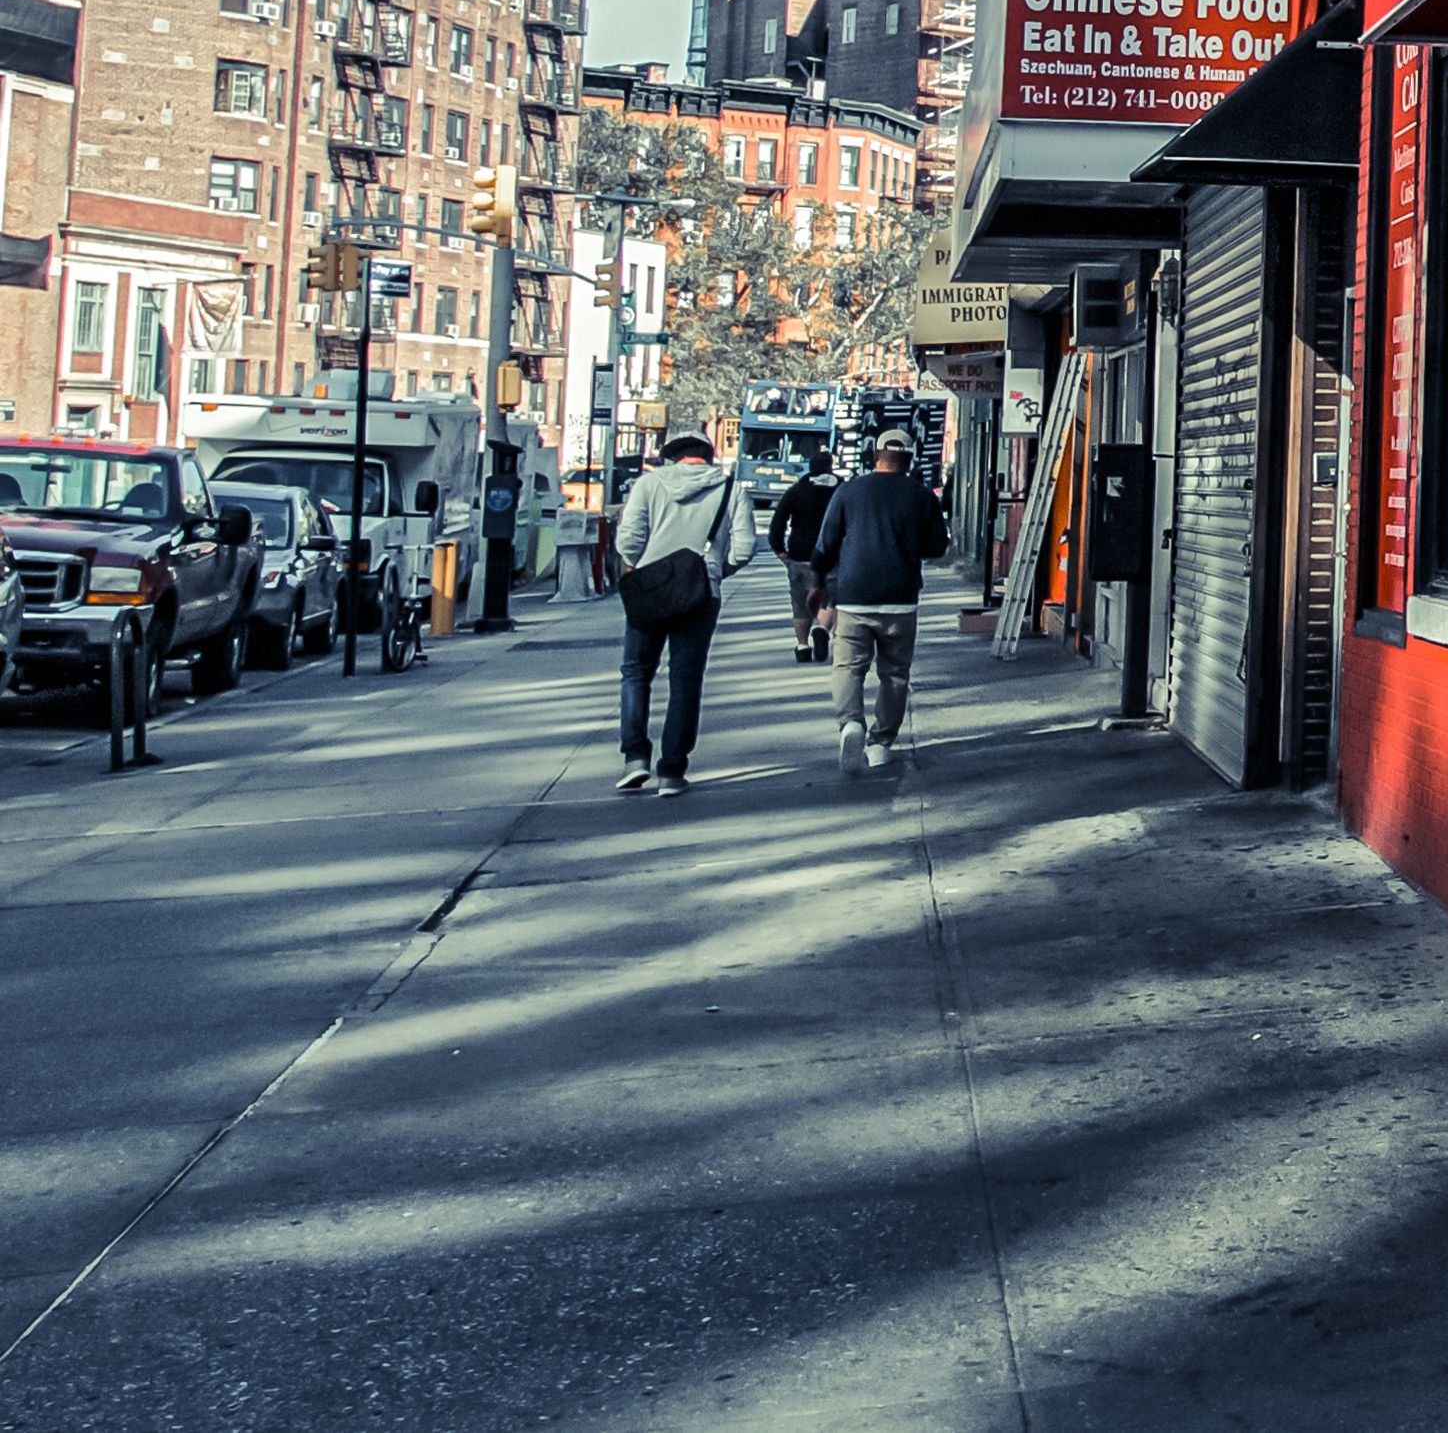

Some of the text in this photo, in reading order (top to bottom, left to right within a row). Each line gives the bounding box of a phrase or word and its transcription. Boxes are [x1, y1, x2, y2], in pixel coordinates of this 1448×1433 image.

[1023, 22, 1286, 61] Eat In & Take Out
[1020, 58, 1097, 79] Szechuan,
[1101, 61, 1179, 80] Cantonese
[1184, 65, 1195, 80] &
[1200, 65, 1245, 82] Hunan
[1020, 85, 1058, 106] Tel:
[1064, 87, 1117, 110] (212)
[300, 424, 348, 438] verizon
